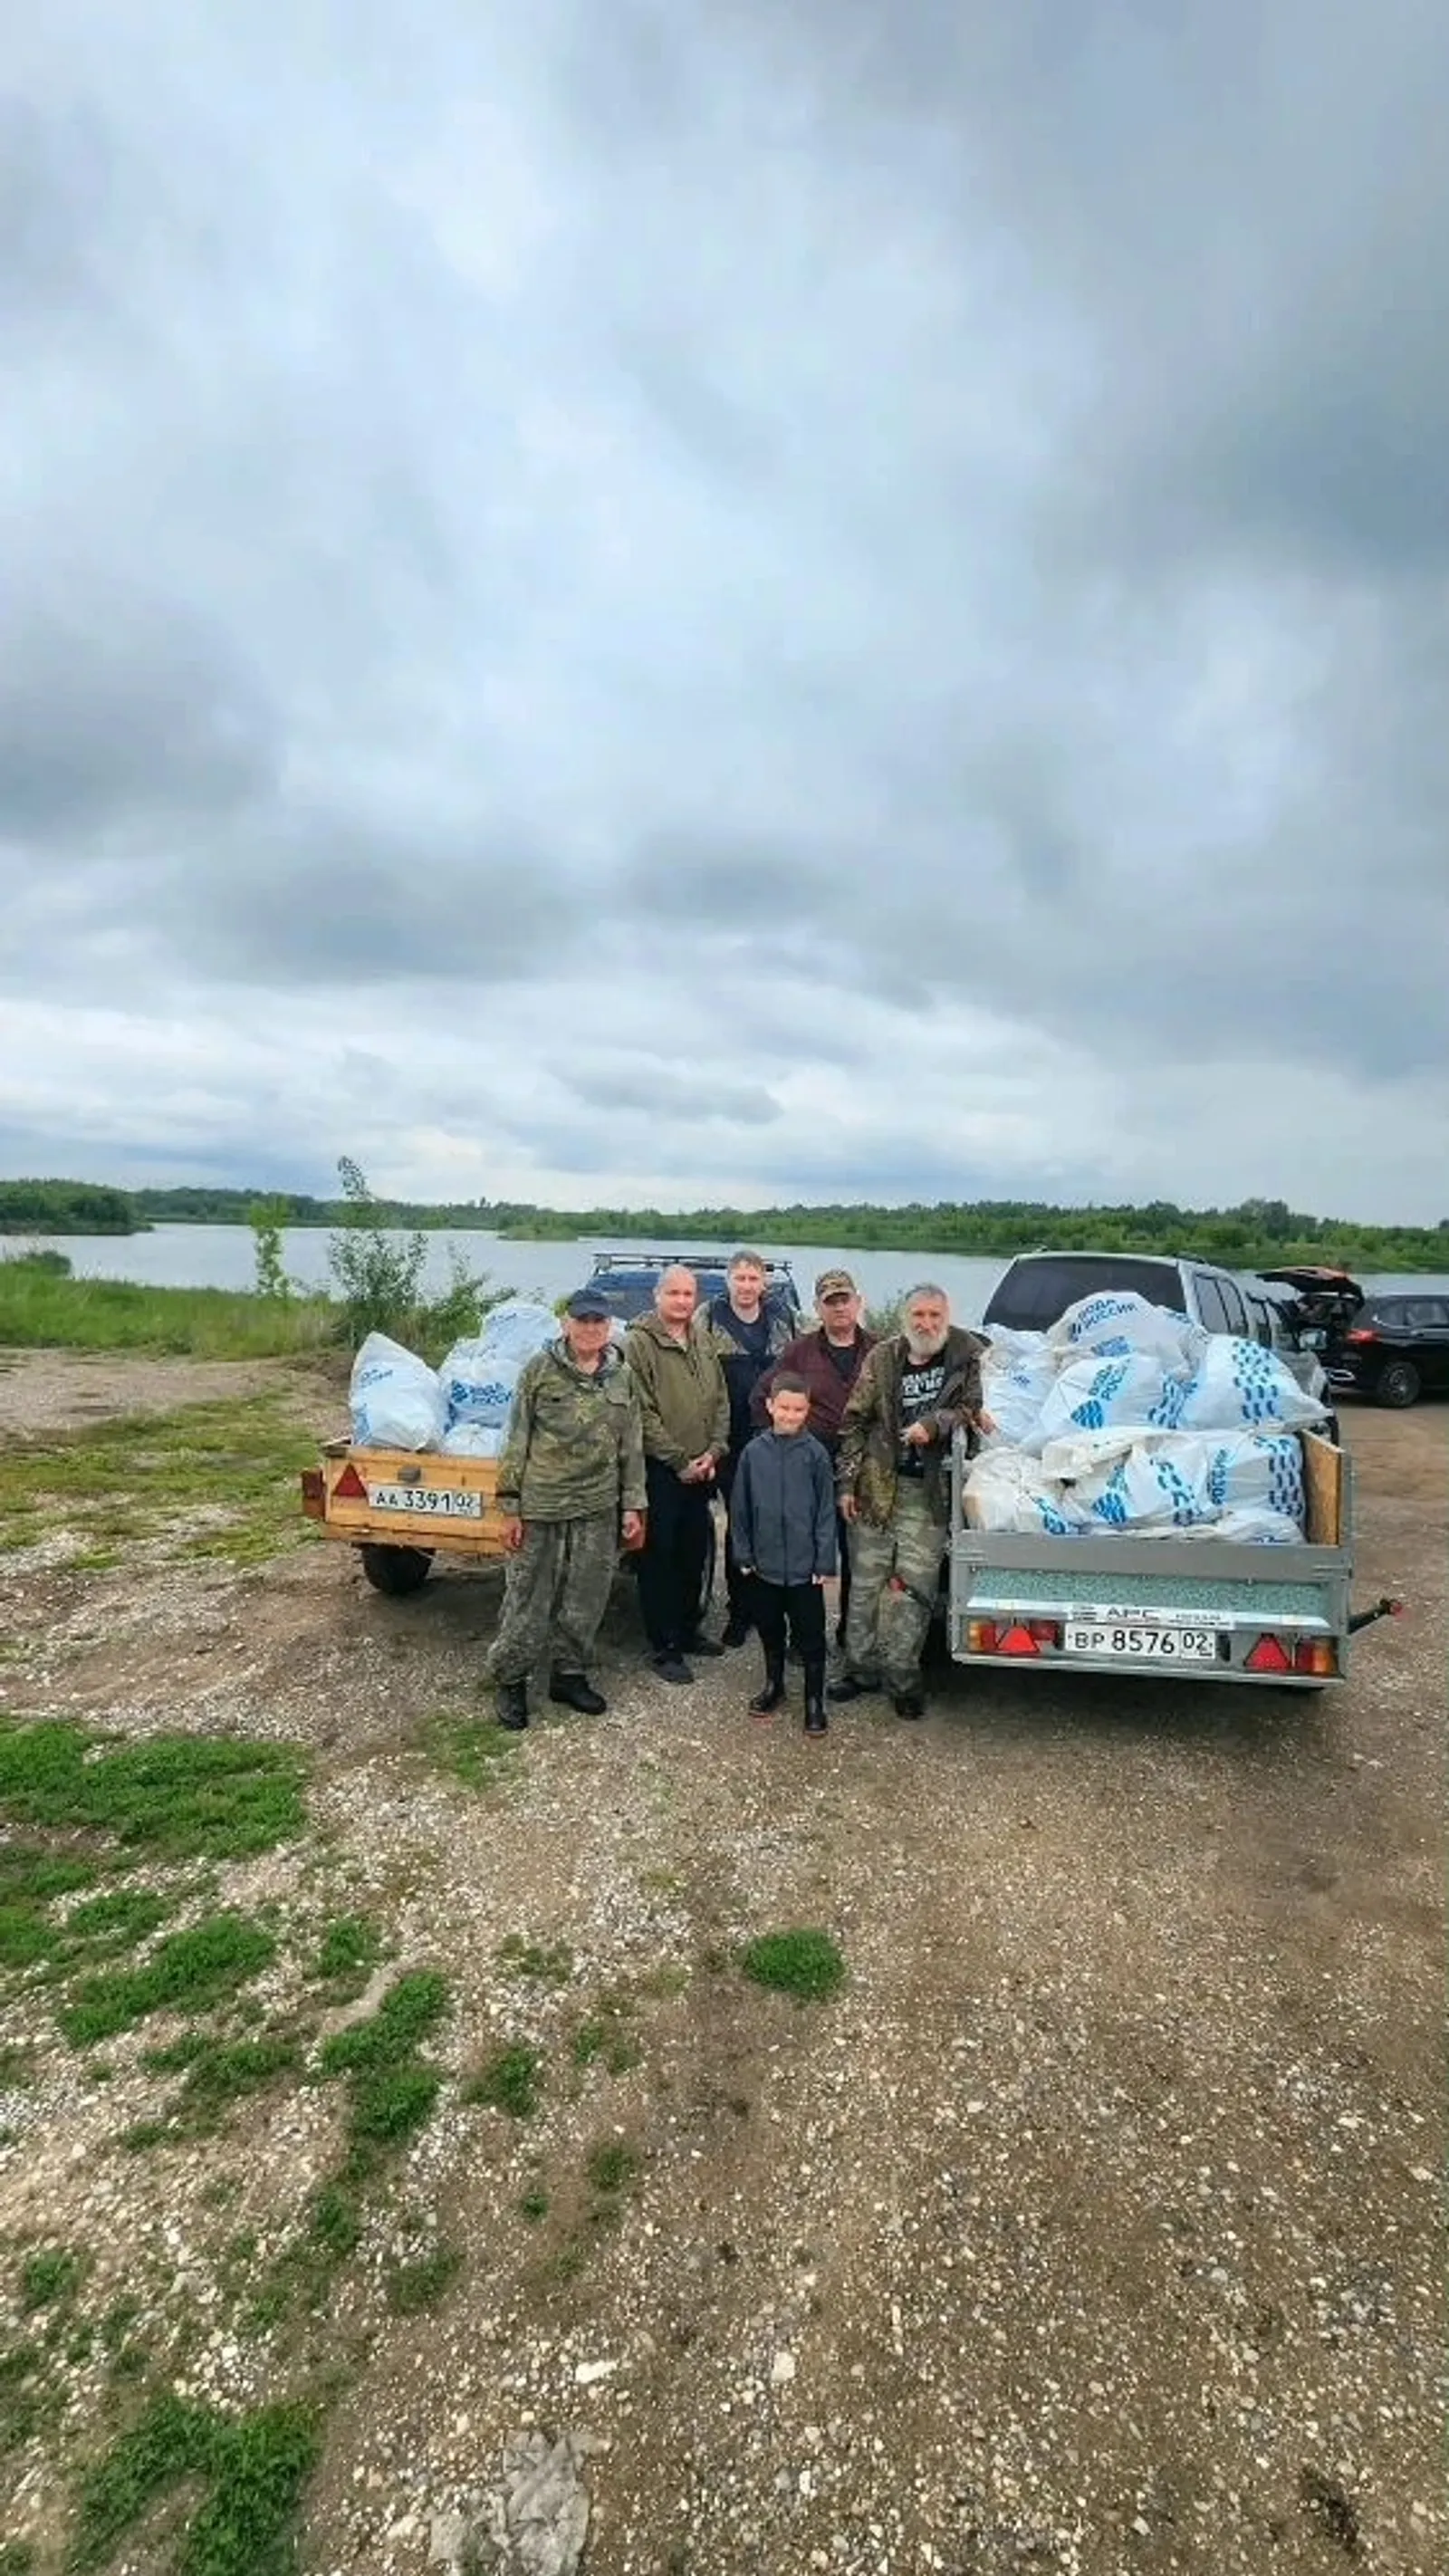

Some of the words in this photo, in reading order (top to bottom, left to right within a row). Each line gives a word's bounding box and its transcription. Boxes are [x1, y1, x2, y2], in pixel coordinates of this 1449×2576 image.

[403, 1490, 451, 1512] 3391
[1074, 1631, 1106, 1649] ВР
[1111, 1629, 1176, 1655] 8576
[1182, 1631, 1209, 1651] 02
